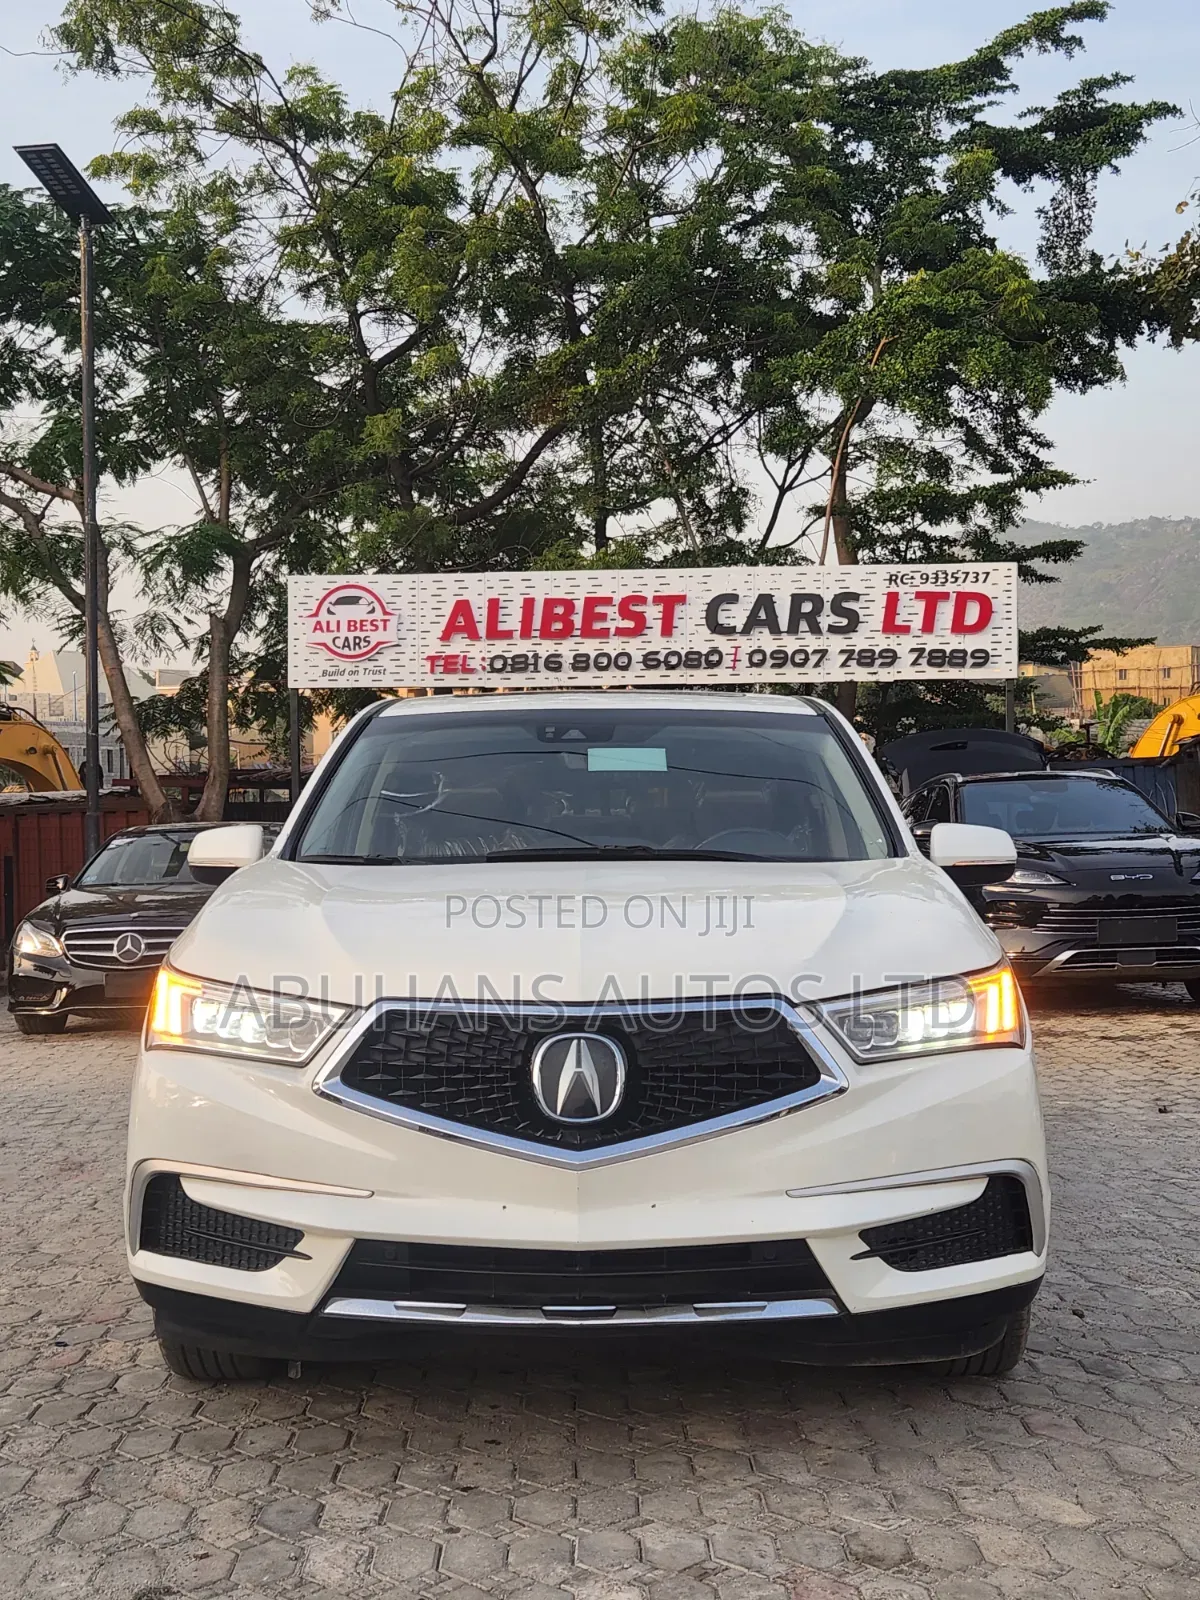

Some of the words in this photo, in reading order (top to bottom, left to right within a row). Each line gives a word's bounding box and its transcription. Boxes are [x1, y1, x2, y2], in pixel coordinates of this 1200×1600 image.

[919, 571, 991, 585] 9335737
[440, 594, 687, 642] ALIBEST
[704, 592, 861, 637] CARS
[881, 590, 993, 636] LTD
[312, 620, 340, 633] ALI
[347, 619, 391, 632] BEST
[332, 636, 371, 651] CARS
[489, 652, 564, 673] 0816
[571, 651, 633, 672] 800
[642, 649, 724, 671] 6080
[748, 647, 829, 670] 0907
[838, 646, 898, 669] 789
[909, 646, 990, 669] 7889
[321, 668, 347, 677] Build
[348, 668, 359, 676] on
[363, 667, 387, 676] Trust
